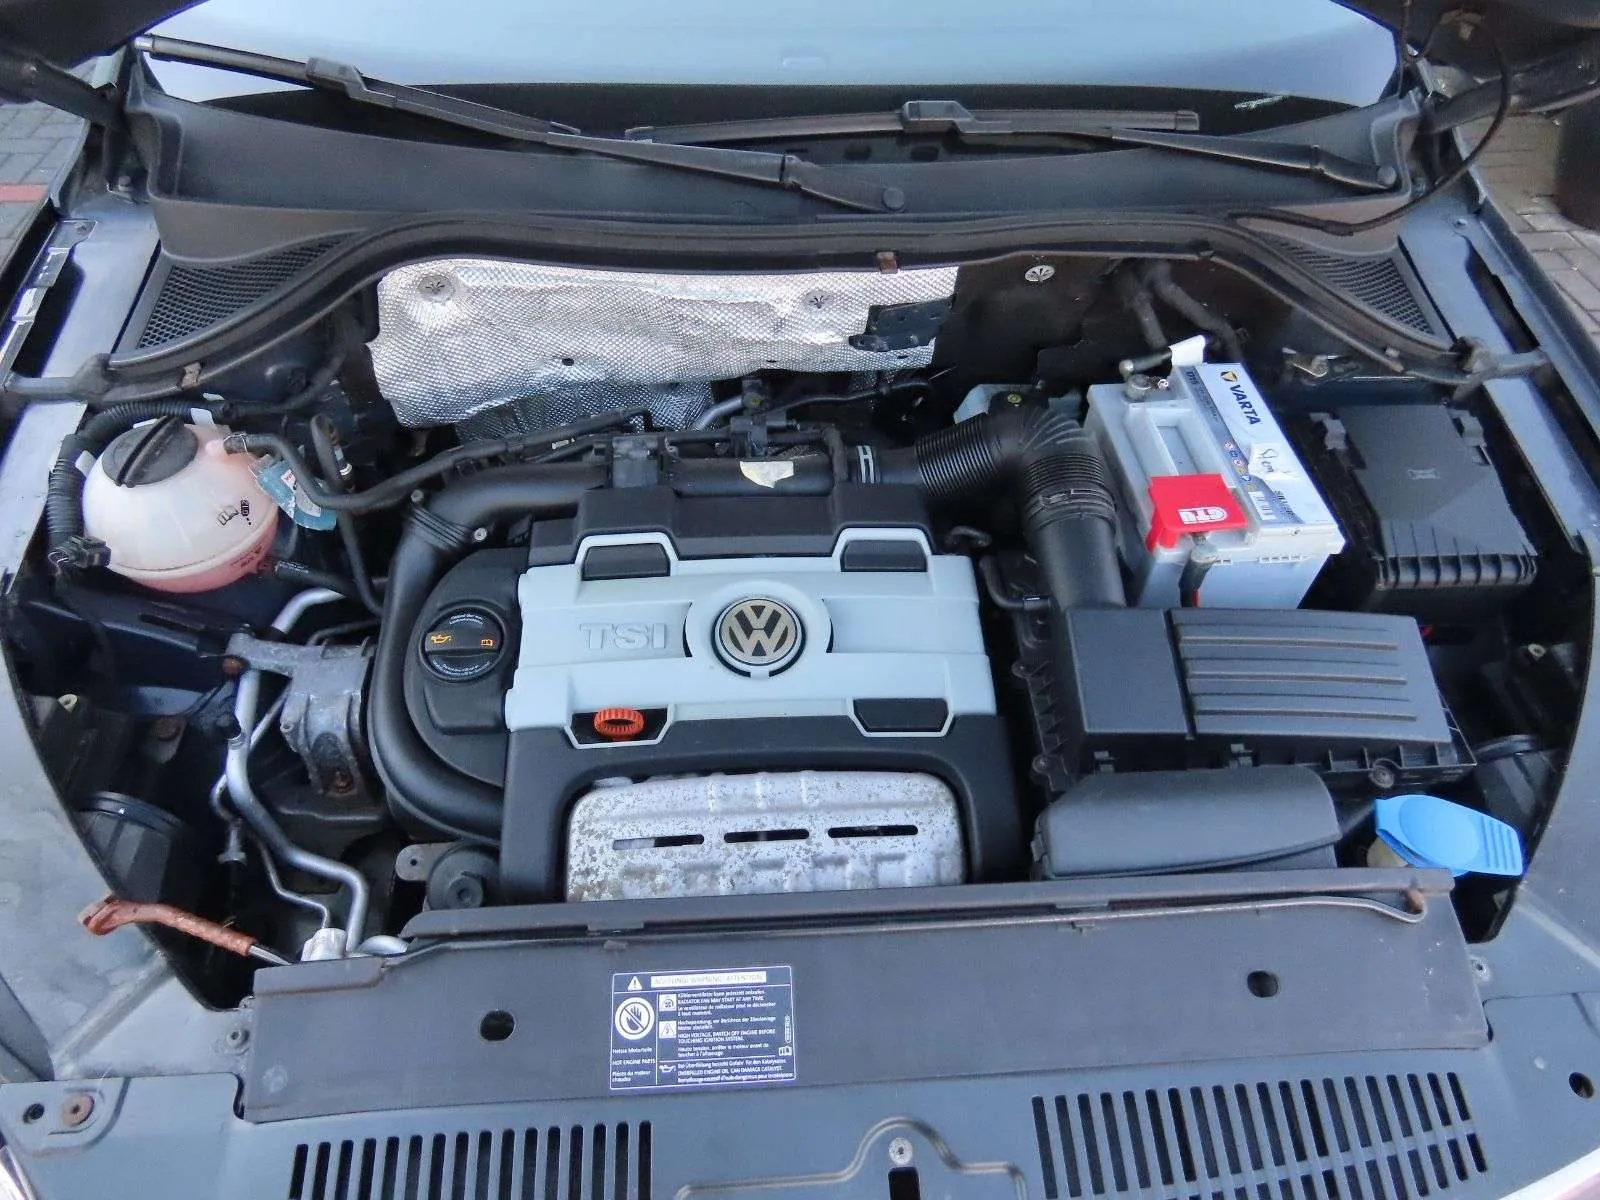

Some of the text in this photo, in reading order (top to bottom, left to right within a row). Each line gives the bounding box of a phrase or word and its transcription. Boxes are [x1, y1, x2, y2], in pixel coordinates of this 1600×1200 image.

[1230, 384, 1262, 425] VARTA
[580, 622, 668, 650] TSI
[718, 598, 799, 667] VW
